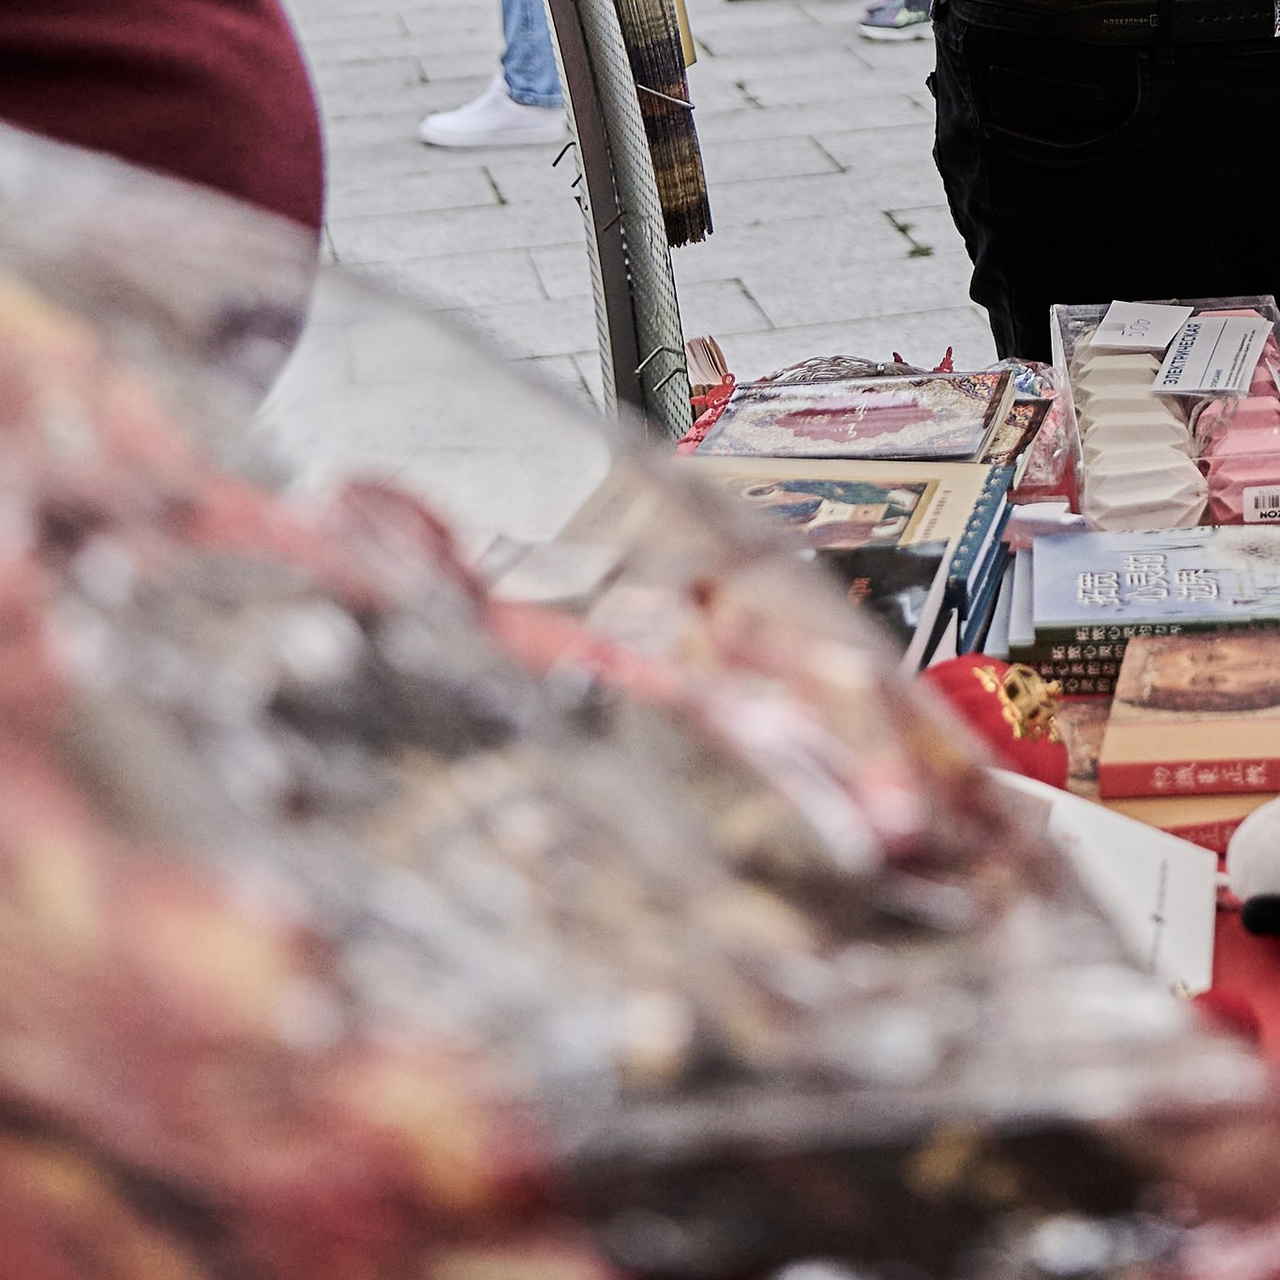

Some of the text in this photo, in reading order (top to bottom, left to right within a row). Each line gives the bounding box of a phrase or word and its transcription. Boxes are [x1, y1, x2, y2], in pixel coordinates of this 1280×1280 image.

[1161, 322, 1203, 386] ЭЛЕКТРИЧЕСКАЯ
[1122, 552, 1170, 603] 心灵的
